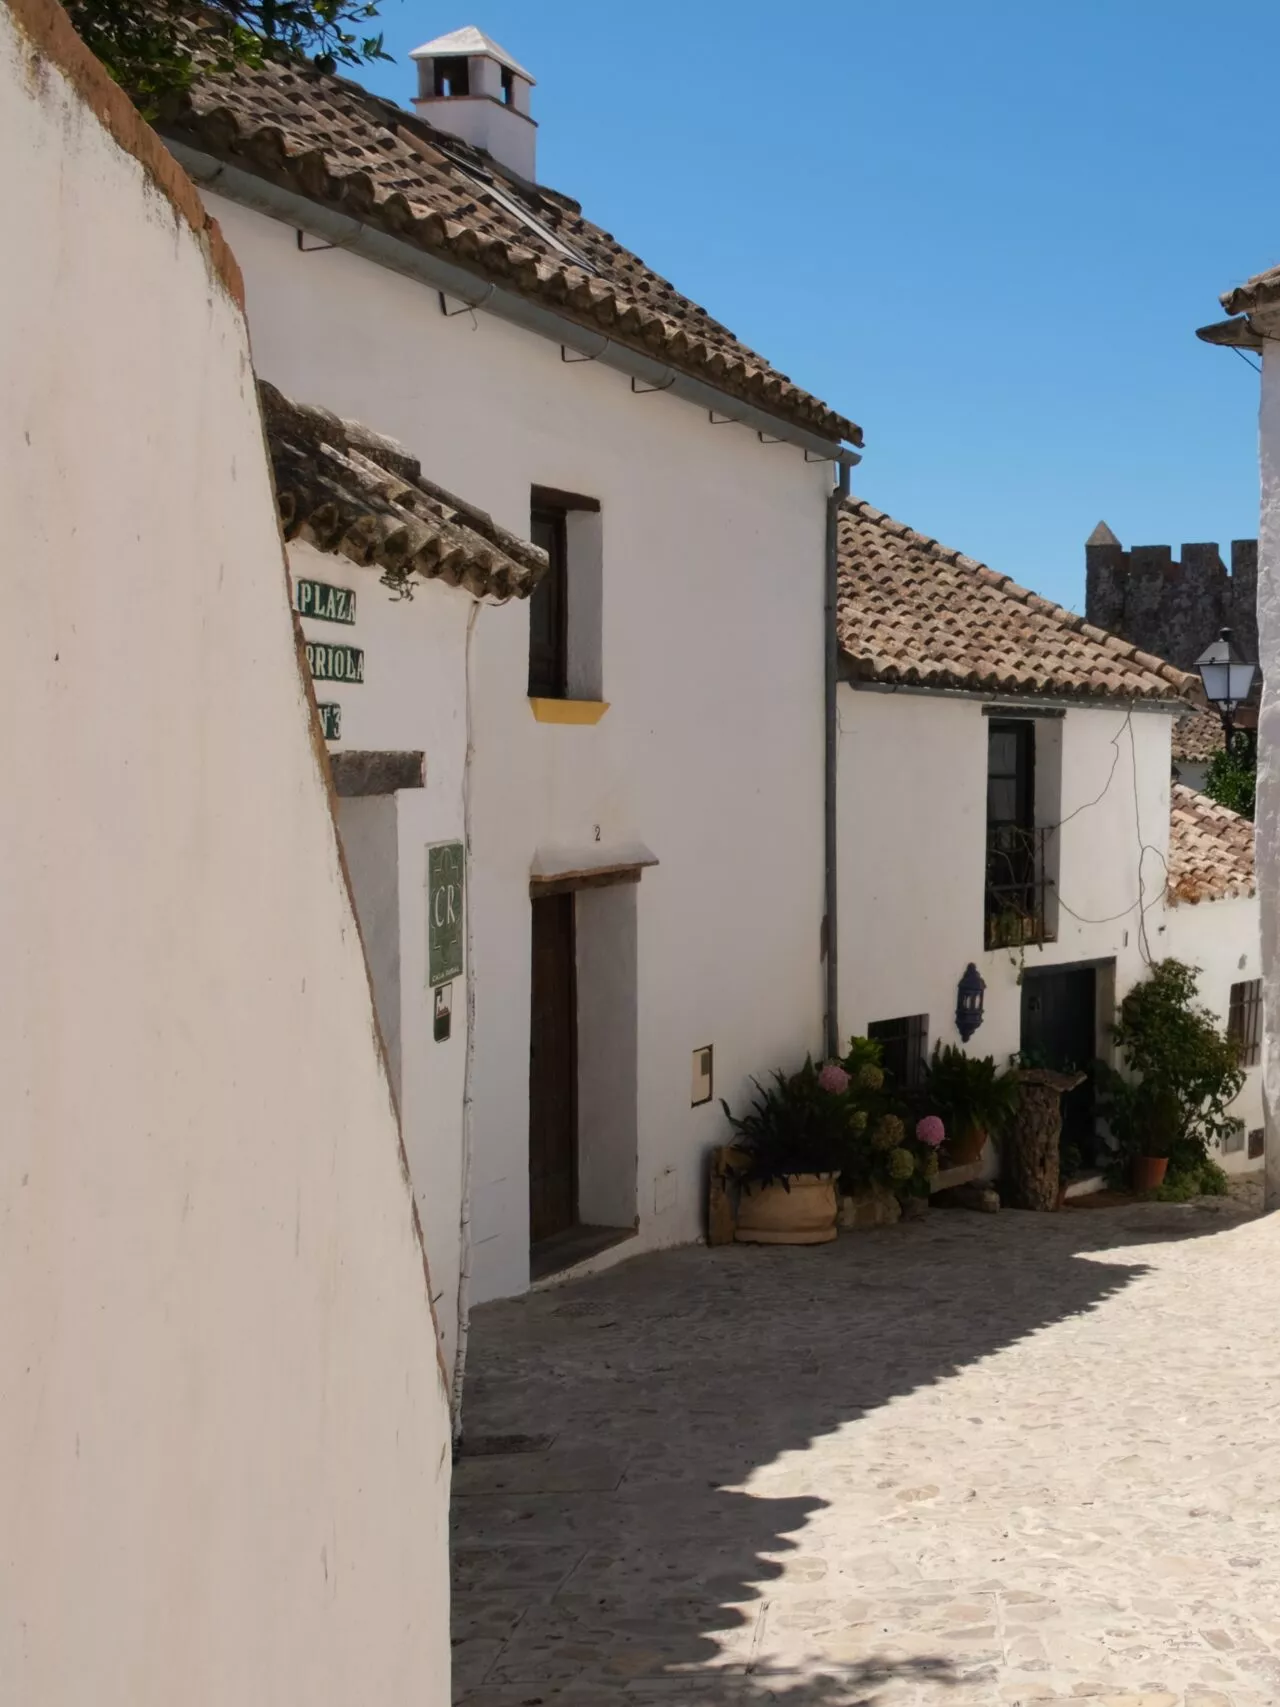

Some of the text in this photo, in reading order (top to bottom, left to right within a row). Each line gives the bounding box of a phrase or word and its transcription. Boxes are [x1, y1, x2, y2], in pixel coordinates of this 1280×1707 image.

[301, 583, 356, 622] PLAZA
[594, 825, 601, 842] 2
[435, 885, 456, 928] CR
